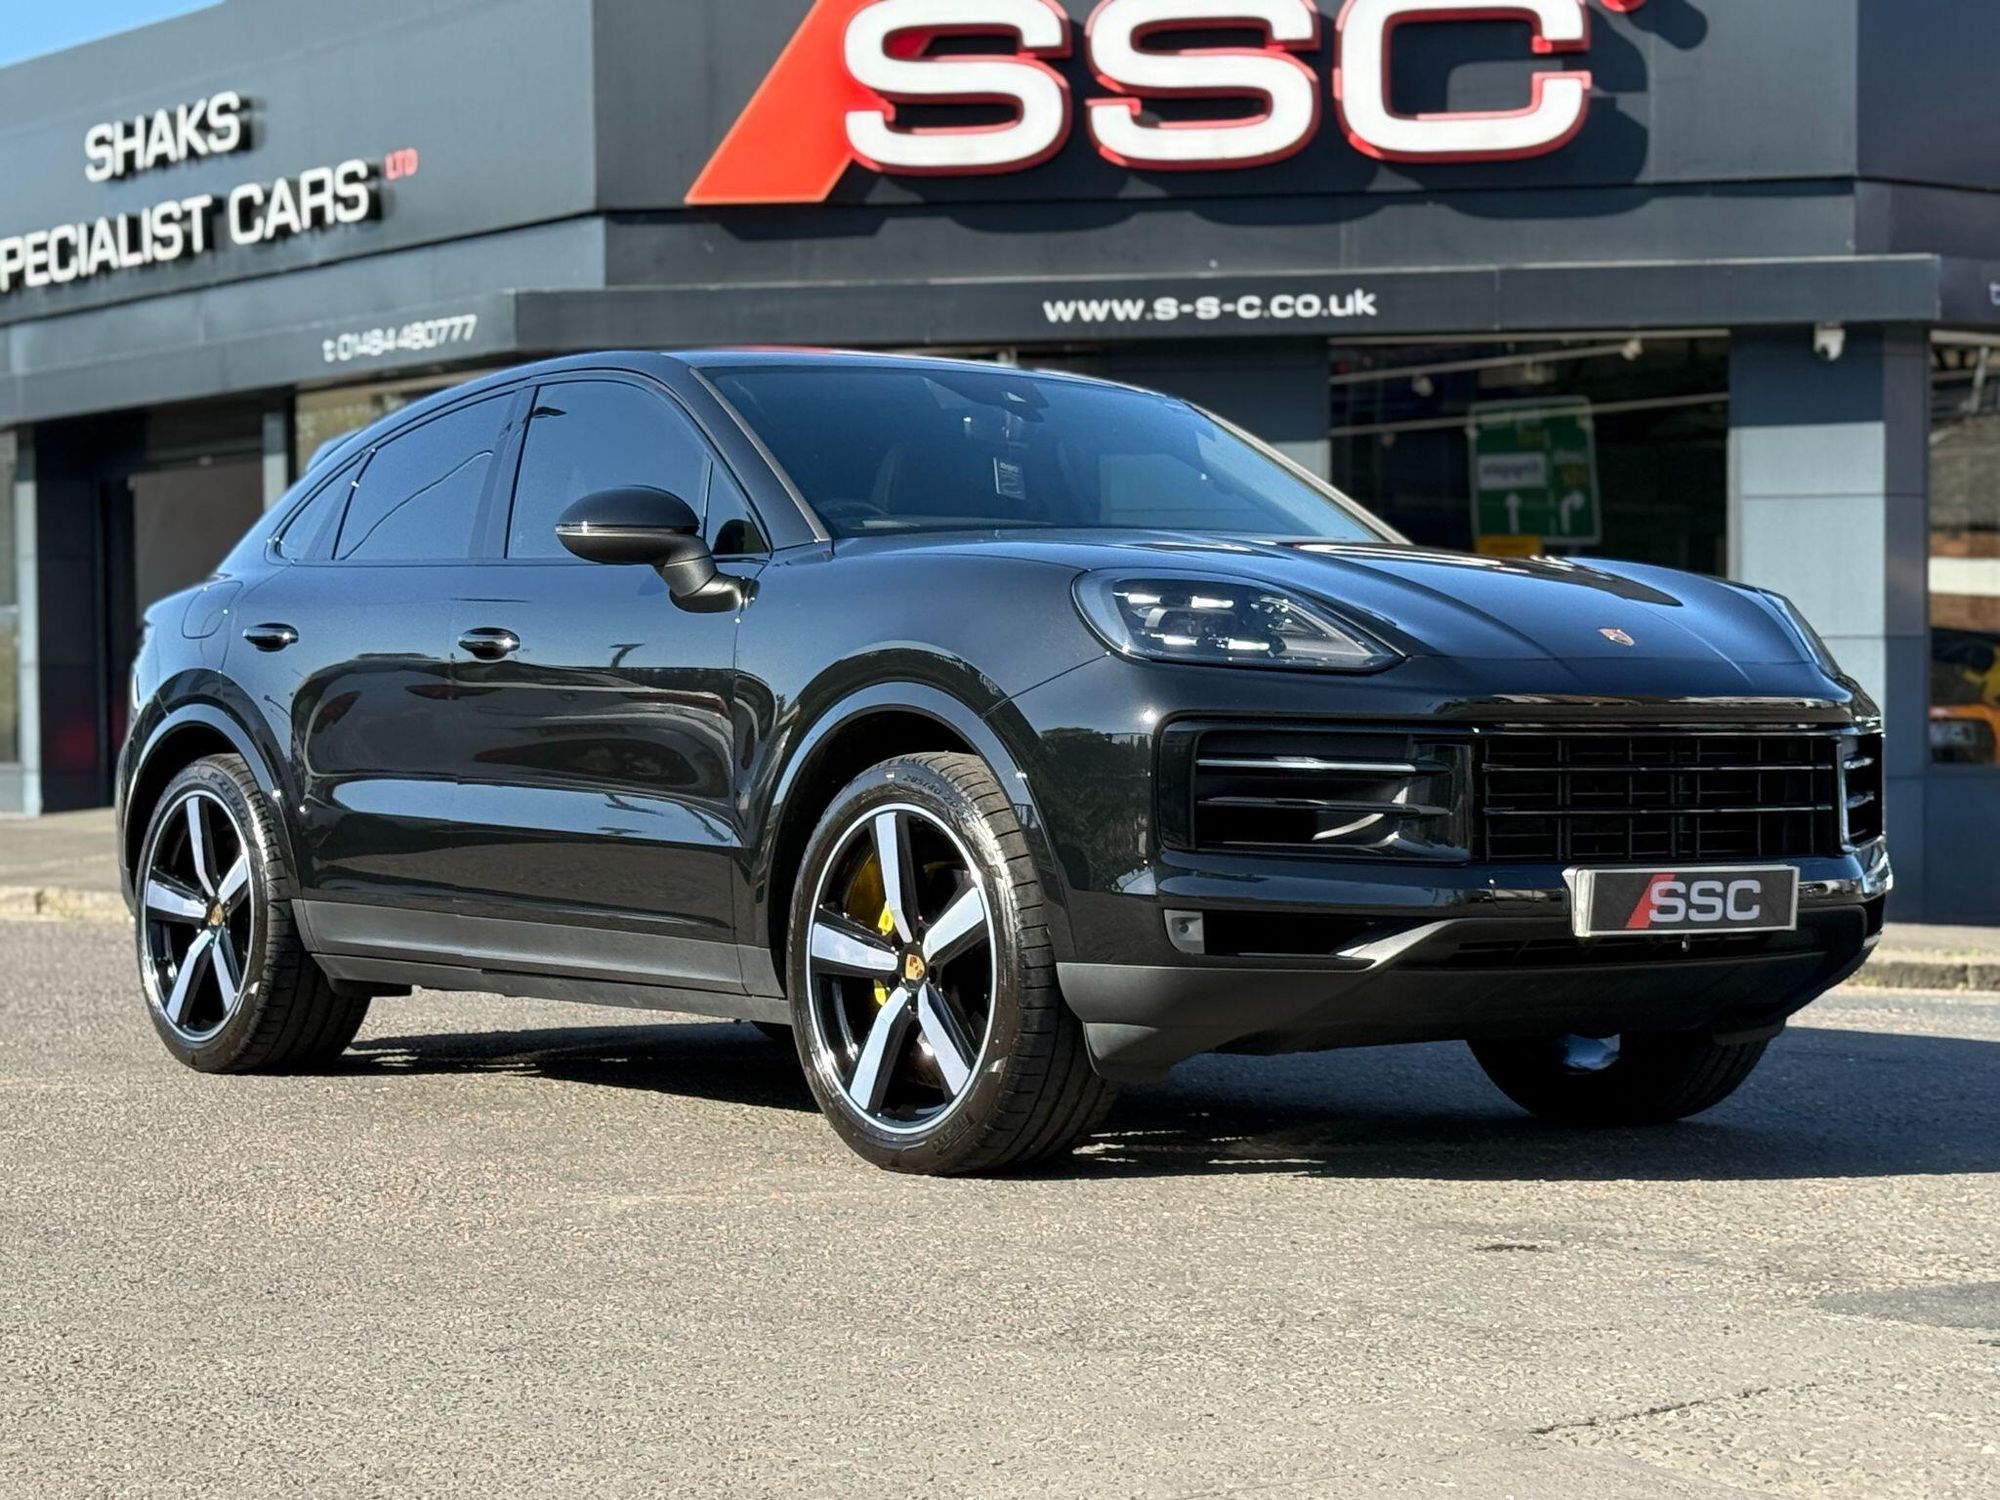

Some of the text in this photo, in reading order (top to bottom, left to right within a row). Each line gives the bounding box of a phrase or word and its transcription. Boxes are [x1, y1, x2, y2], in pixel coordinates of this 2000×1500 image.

[842, 0, 1592, 172] SSC
[84, 90, 243, 183] SHAKS
[229, 159, 370, 246] CARS
[1042, 289, 1378, 323] www.s-s-c.co.uk
[1649, 879, 1762, 923] SSC
